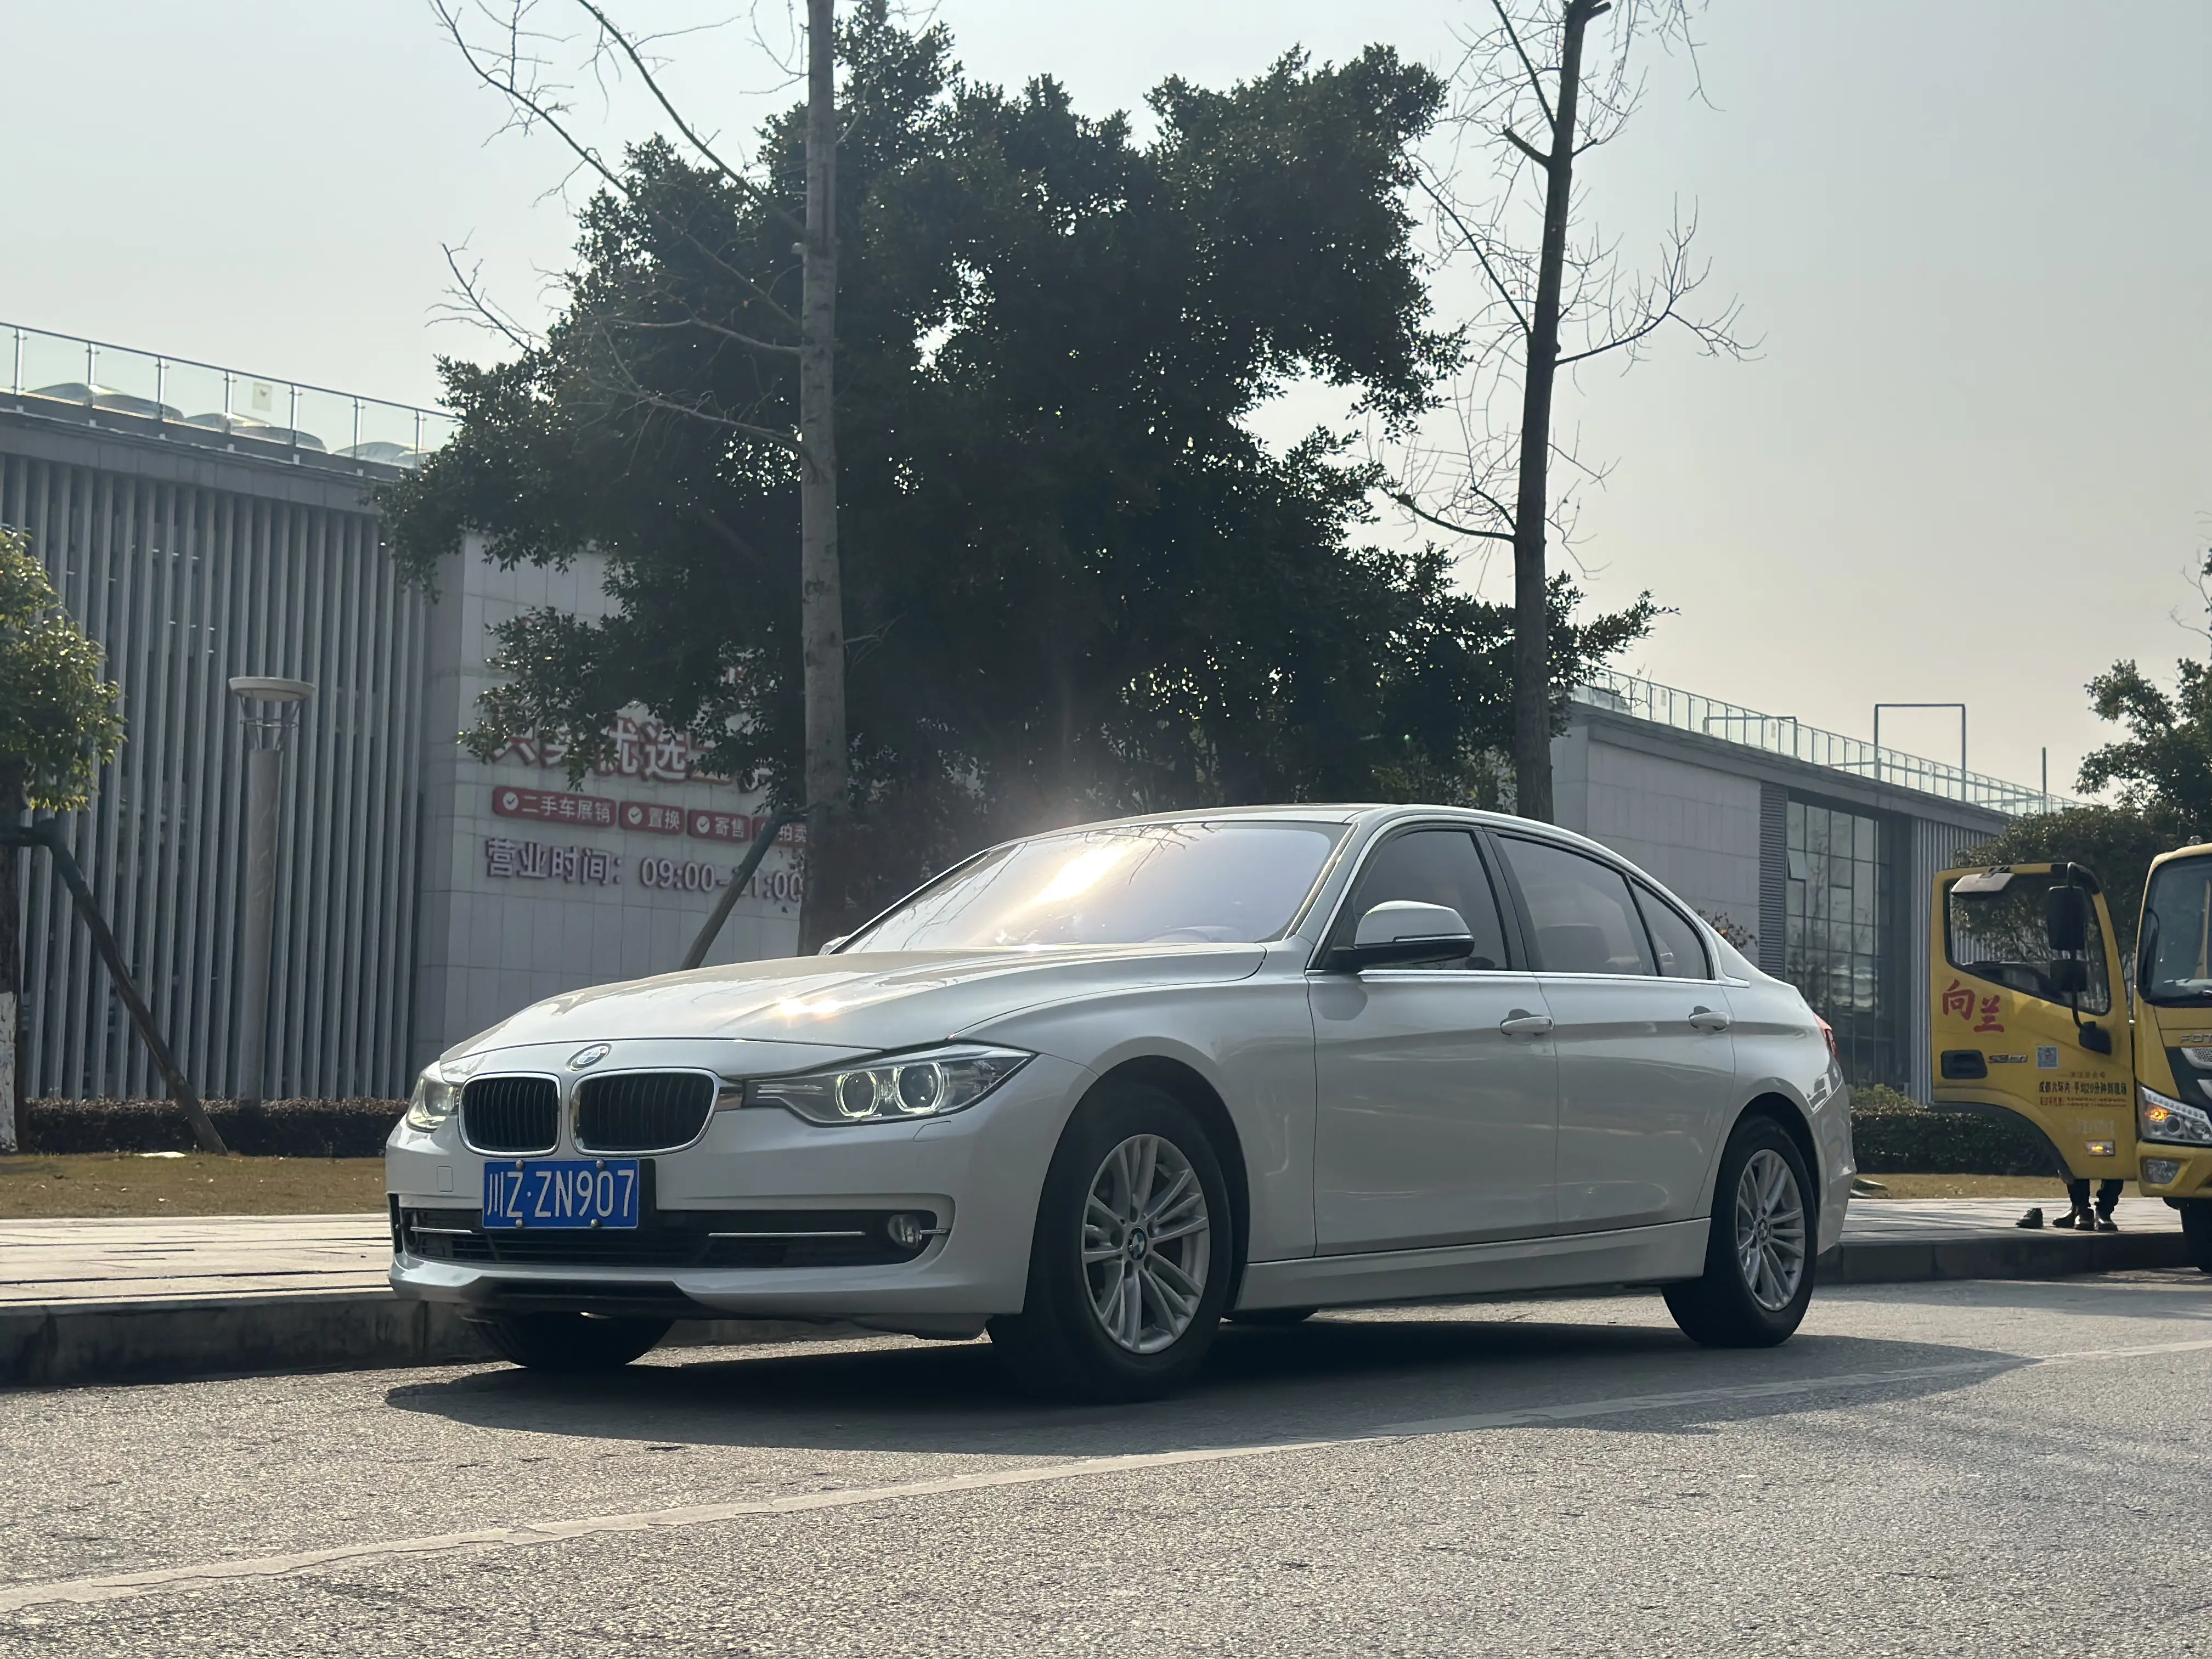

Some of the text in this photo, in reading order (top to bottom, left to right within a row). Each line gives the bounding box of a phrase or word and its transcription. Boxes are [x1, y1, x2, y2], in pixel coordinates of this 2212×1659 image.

[522, 795, 611, 823] 二手车展销
[647, 807, 680, 830] 置换
[715, 816, 744, 838] 寄售
[486, 839, 803, 900] 营业时间： 09:00-1:00
[487, 1169, 635, 1217] 川Z·ZN907
